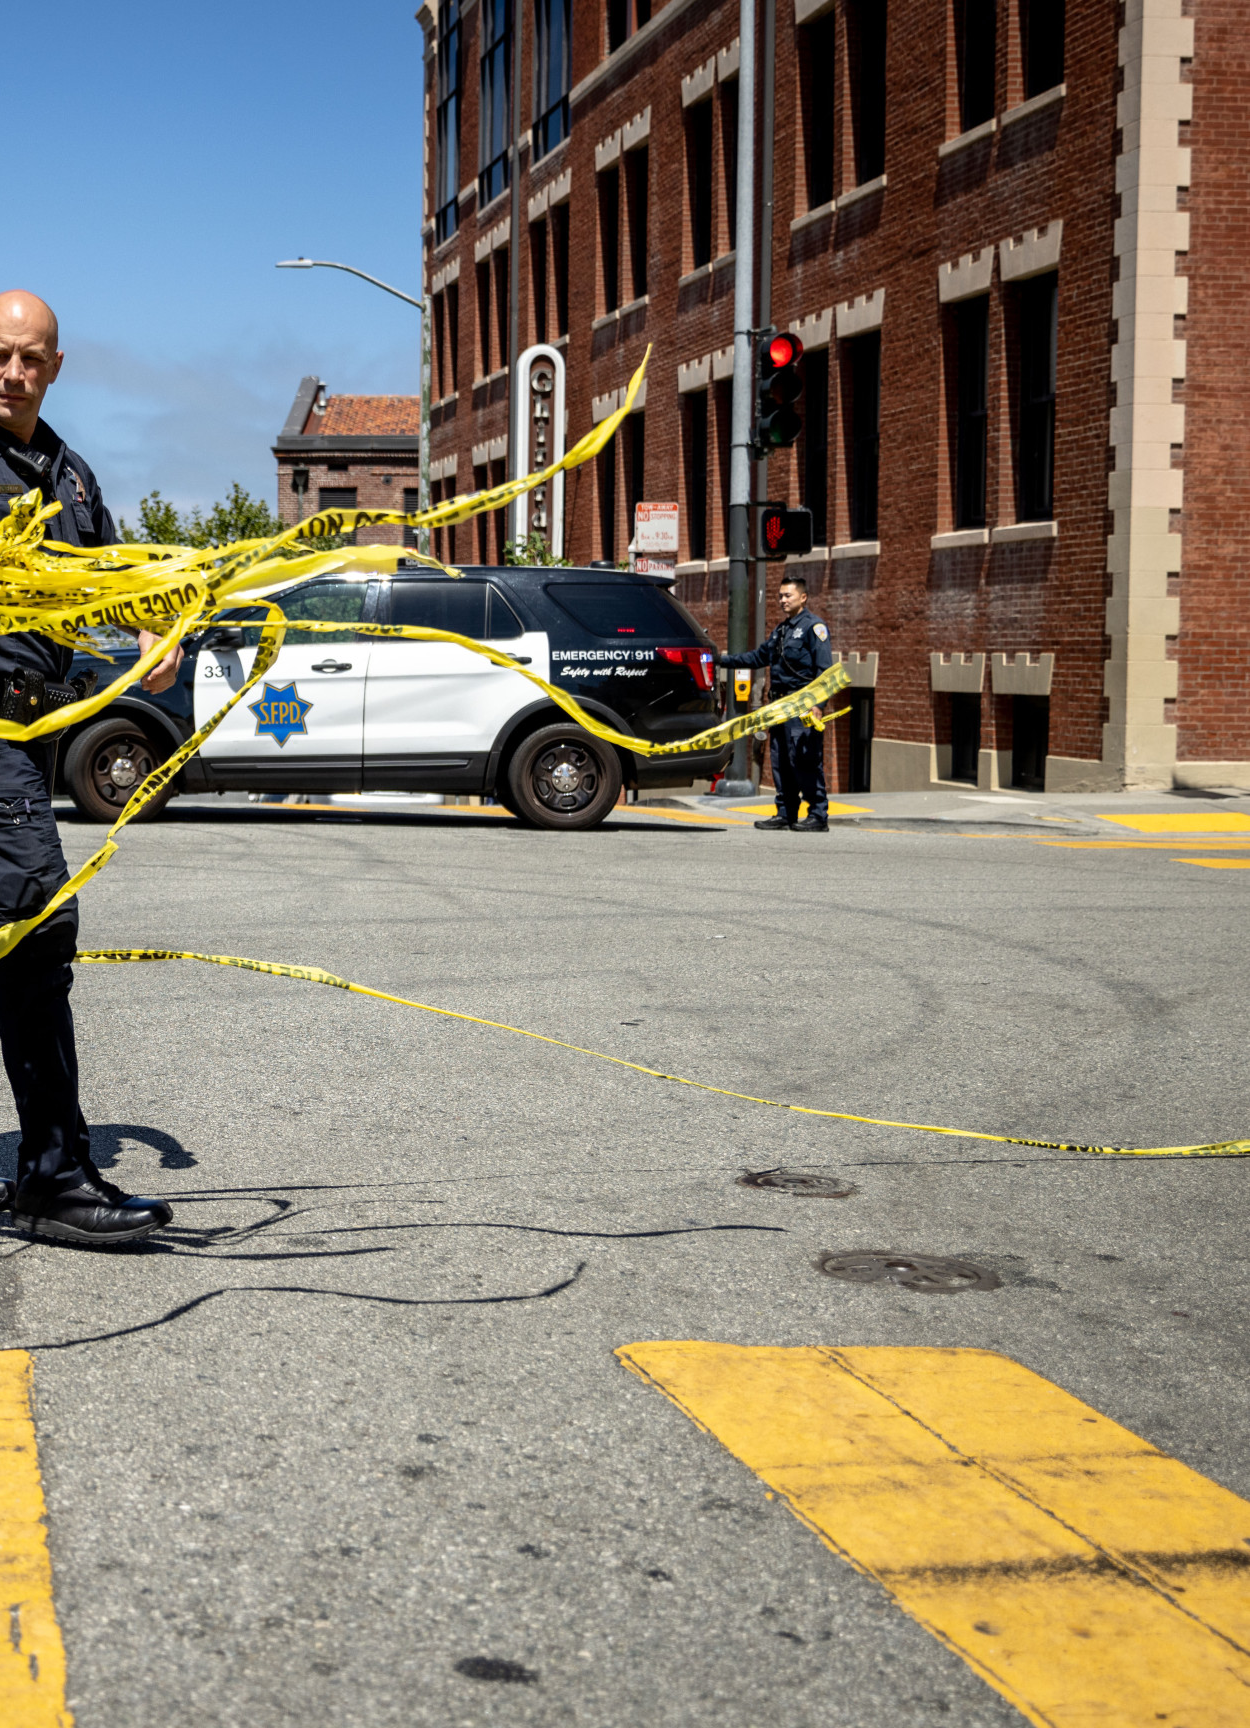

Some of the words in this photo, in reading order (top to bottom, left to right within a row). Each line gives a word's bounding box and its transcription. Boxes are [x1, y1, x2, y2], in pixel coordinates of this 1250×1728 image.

[638, 511, 649, 521] NO
[636, 560, 648, 572] NO
[91, 600, 139, 626] LINE
[552, 650, 630, 660] EMERGENCY
[635, 650, 654, 660] 911
[204, 665, 232, 678] 331
[560, 666, 591, 678] Safety
[592, 666, 614, 676] with
[614, 666, 648, 678] Respect
